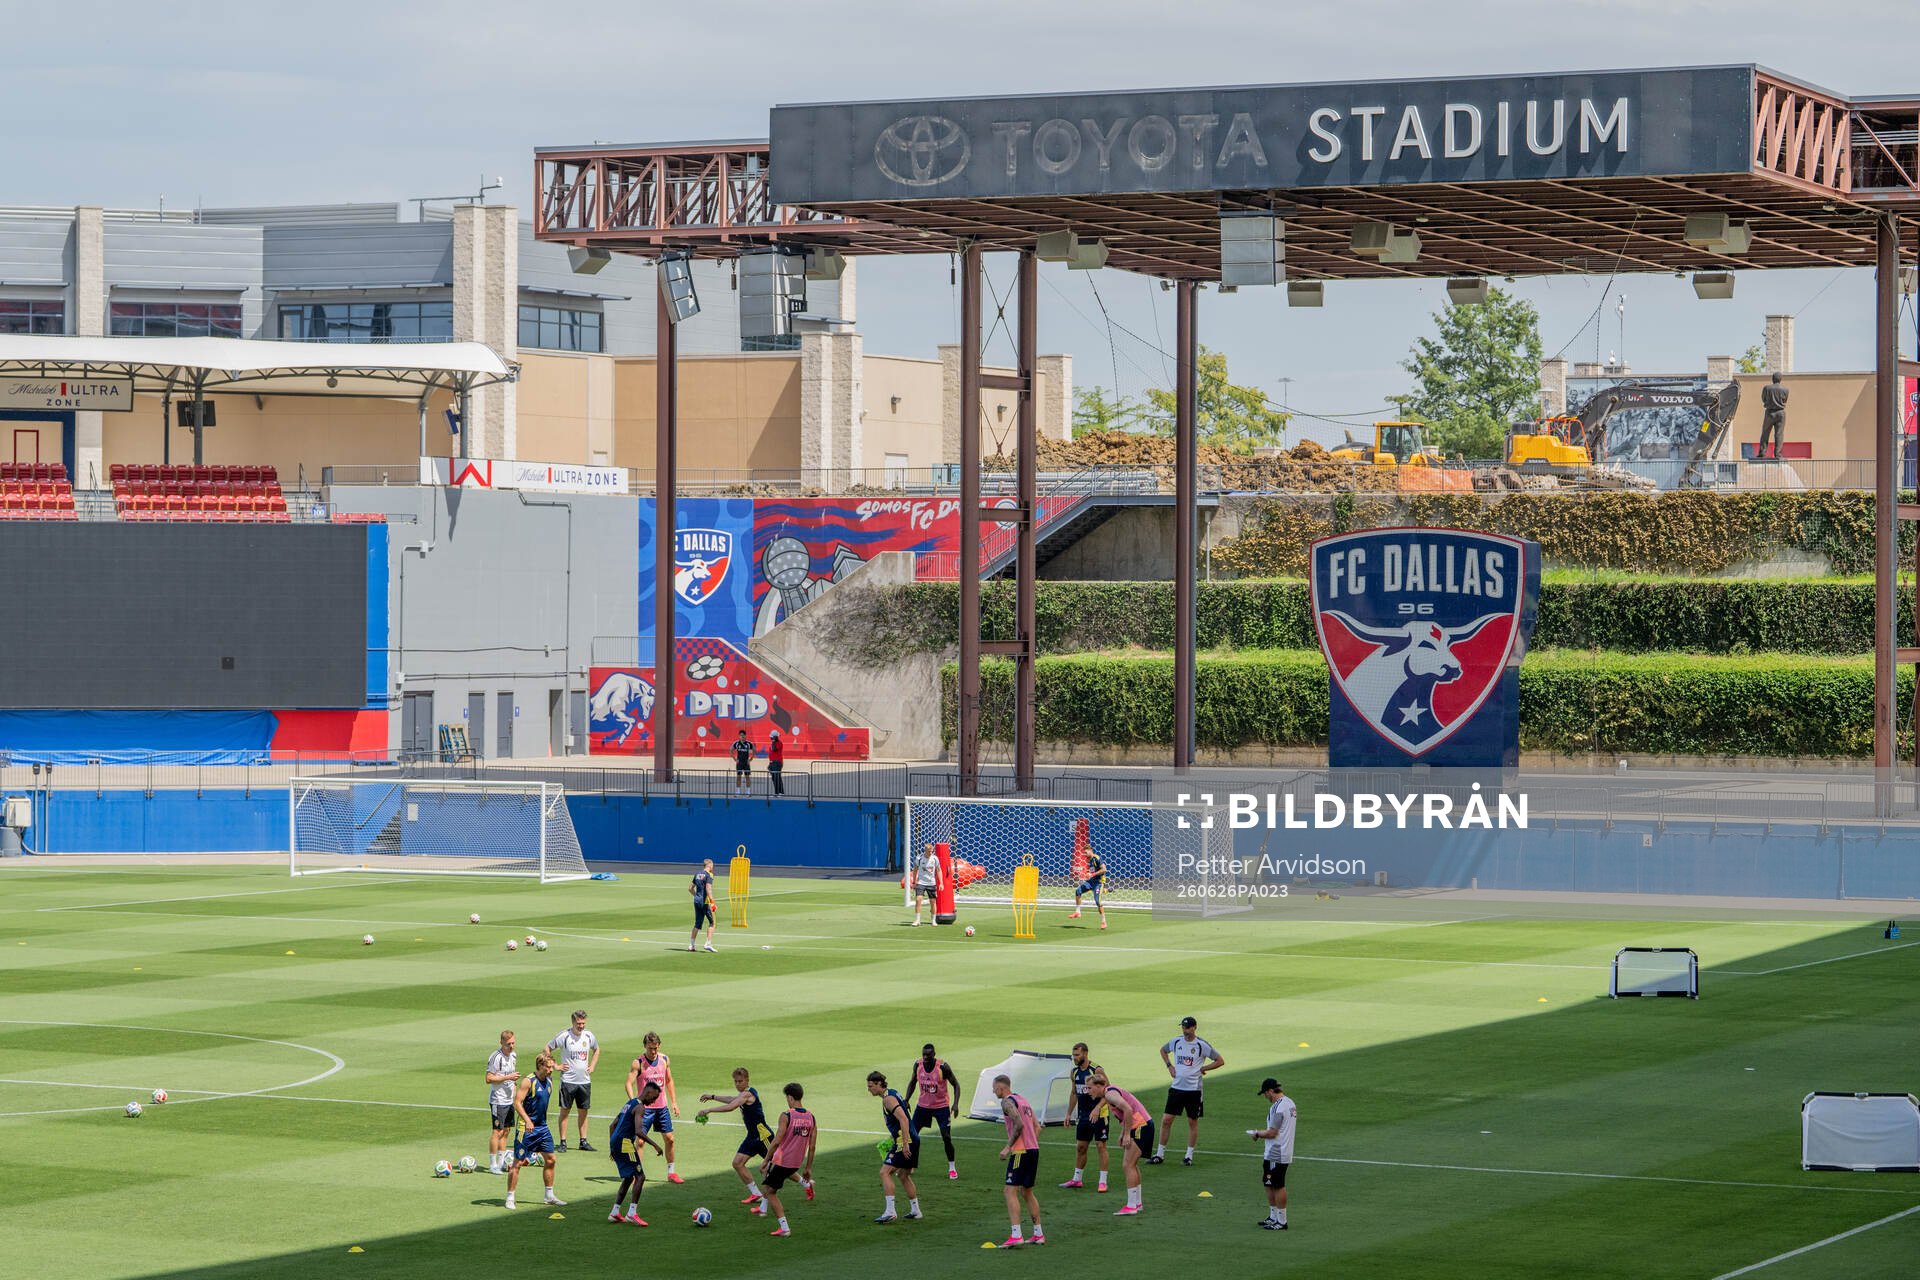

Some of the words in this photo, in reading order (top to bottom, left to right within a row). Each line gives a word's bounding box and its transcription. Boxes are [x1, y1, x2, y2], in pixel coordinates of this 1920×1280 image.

[992, 112, 1268, 176] TOYOTA
[1308, 97, 1628, 163] STADIUM
[8, 383, 57, 395] Michelob
[71, 385, 119, 395] ULTRA
[1651, 395, 1693, 404] VOLVO
[554, 470, 583, 483] ULTRA
[587, 473, 617, 485] ZONE
[855, 501, 910, 522] SOMOS
[911, 502, 935, 530] FC
[683, 533, 726, 552] DALLAS
[1329, 548, 1367, 599] FC
[1383, 543, 1504, 599] DALLAS
[1398, 603, 1434, 614] 96
[685, 690, 768, 720] DTID
